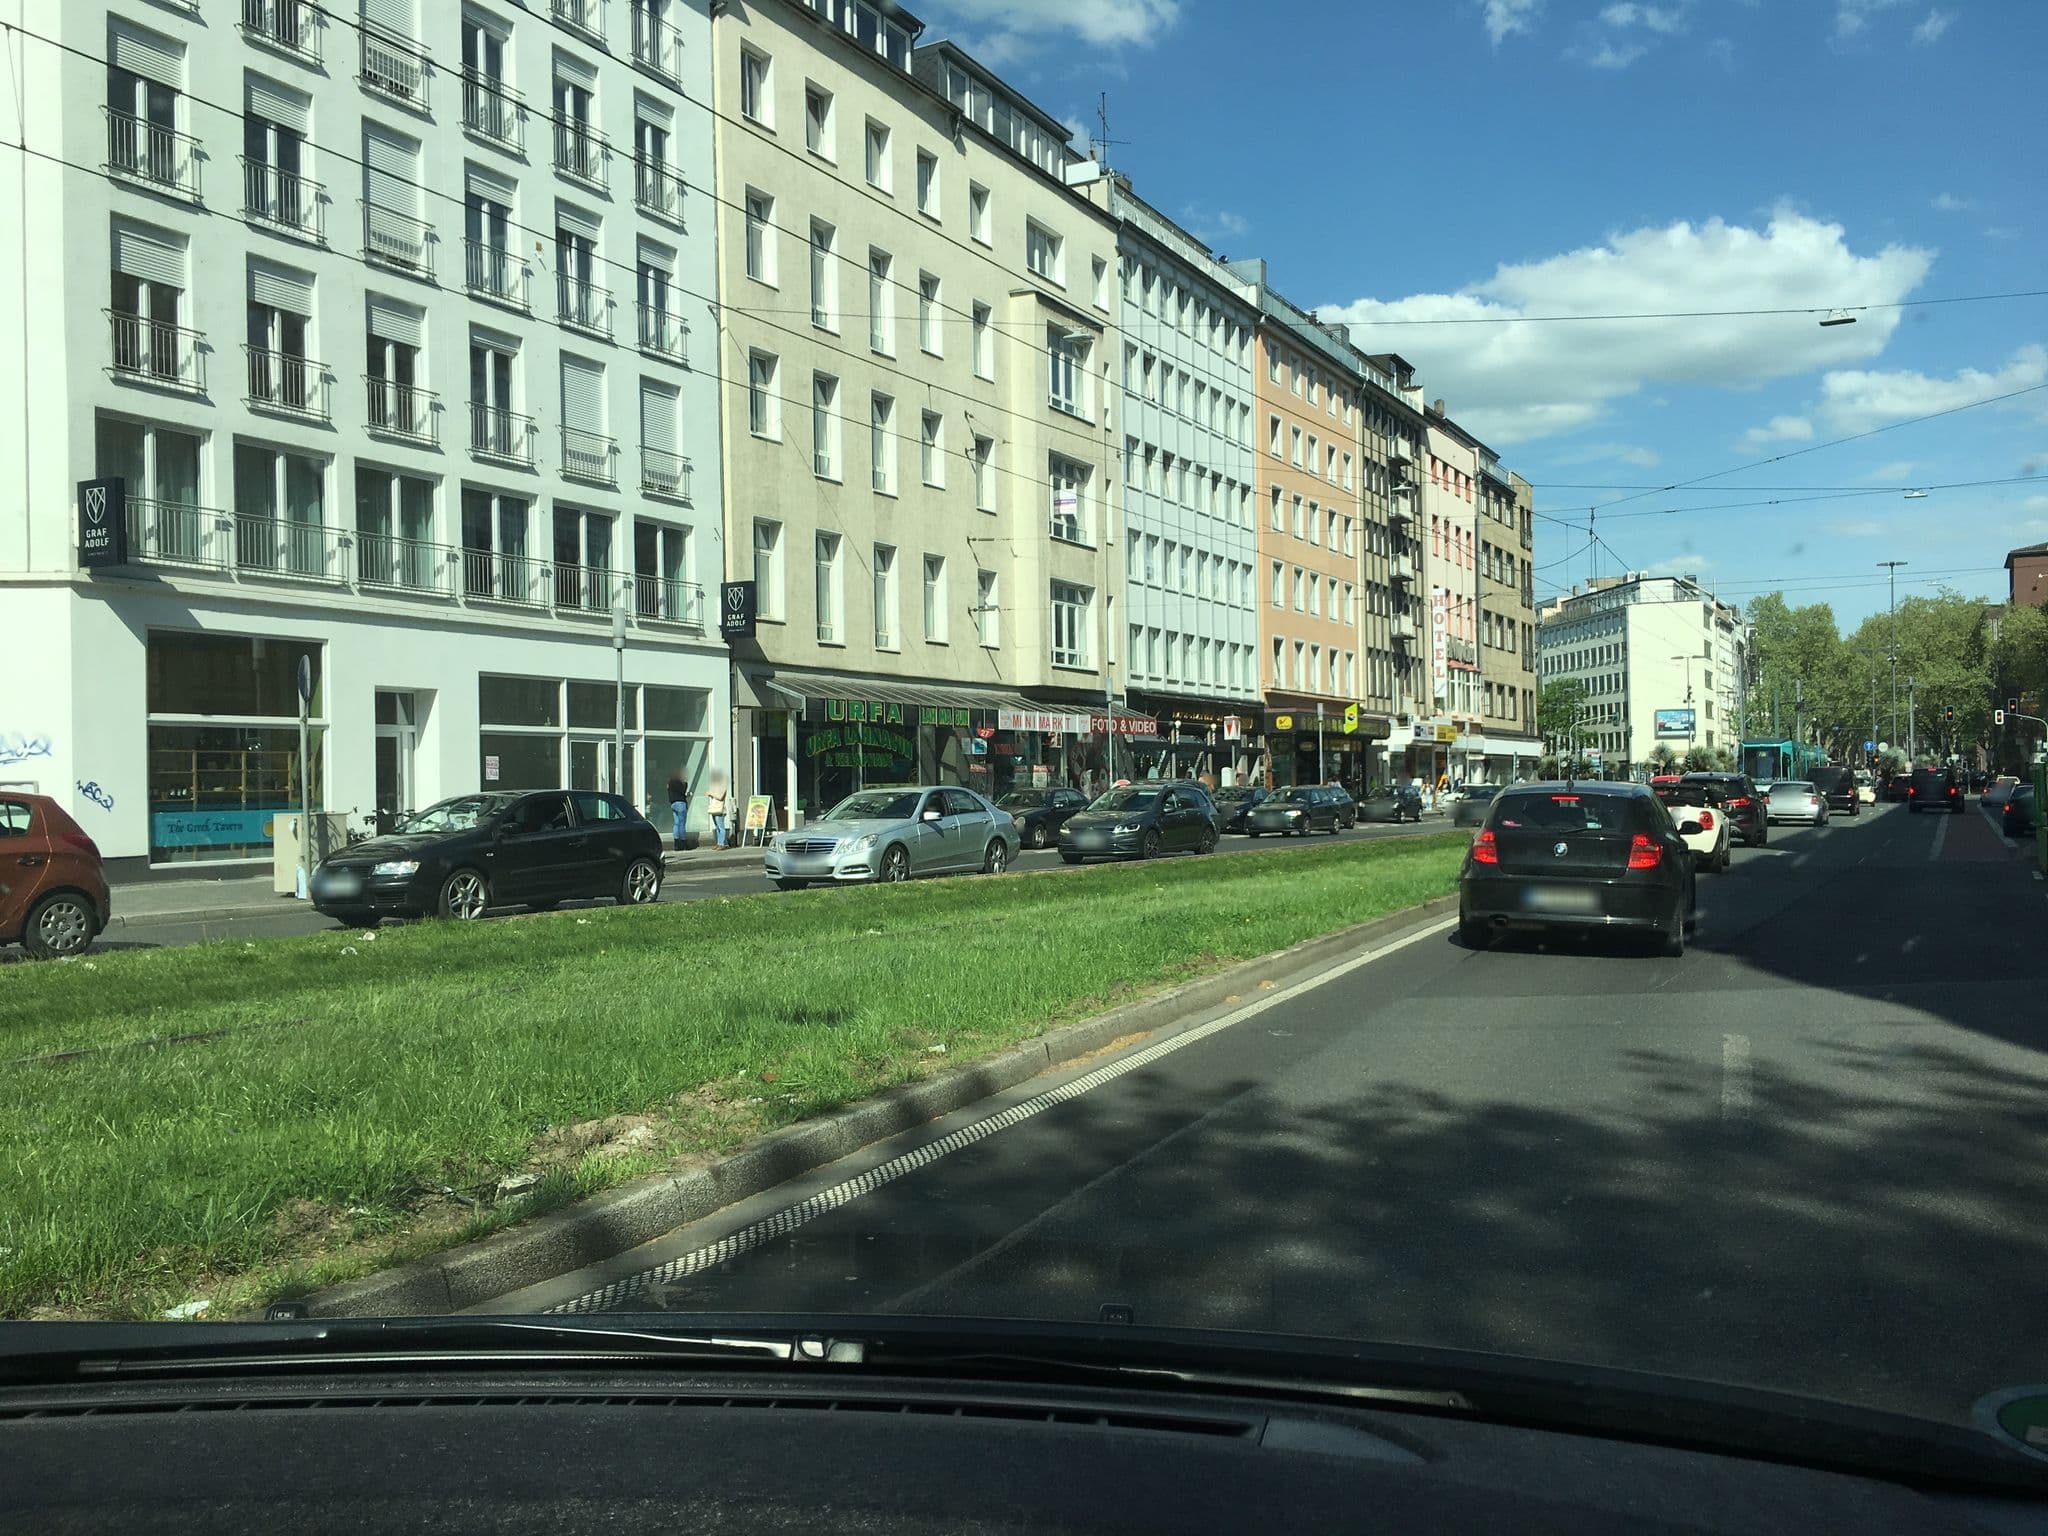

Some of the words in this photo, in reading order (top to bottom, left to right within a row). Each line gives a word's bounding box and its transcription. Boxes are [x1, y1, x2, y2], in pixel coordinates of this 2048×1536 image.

[86, 528, 107, 538] GRAF
[85, 538, 109, 548] ADOLF
[1433, 594, 1445, 679] HOTEL
[828, 699, 903, 723] URFA
[1012, 714, 1036, 729] MINI
[1039, 715, 1070, 731] MARKT
[1091, 718, 1118, 732] FOTO
[1120, 719, 1127, 732] &
[1129, 720, 1156, 733] VIDEO
[168, 820, 184, 833] The
